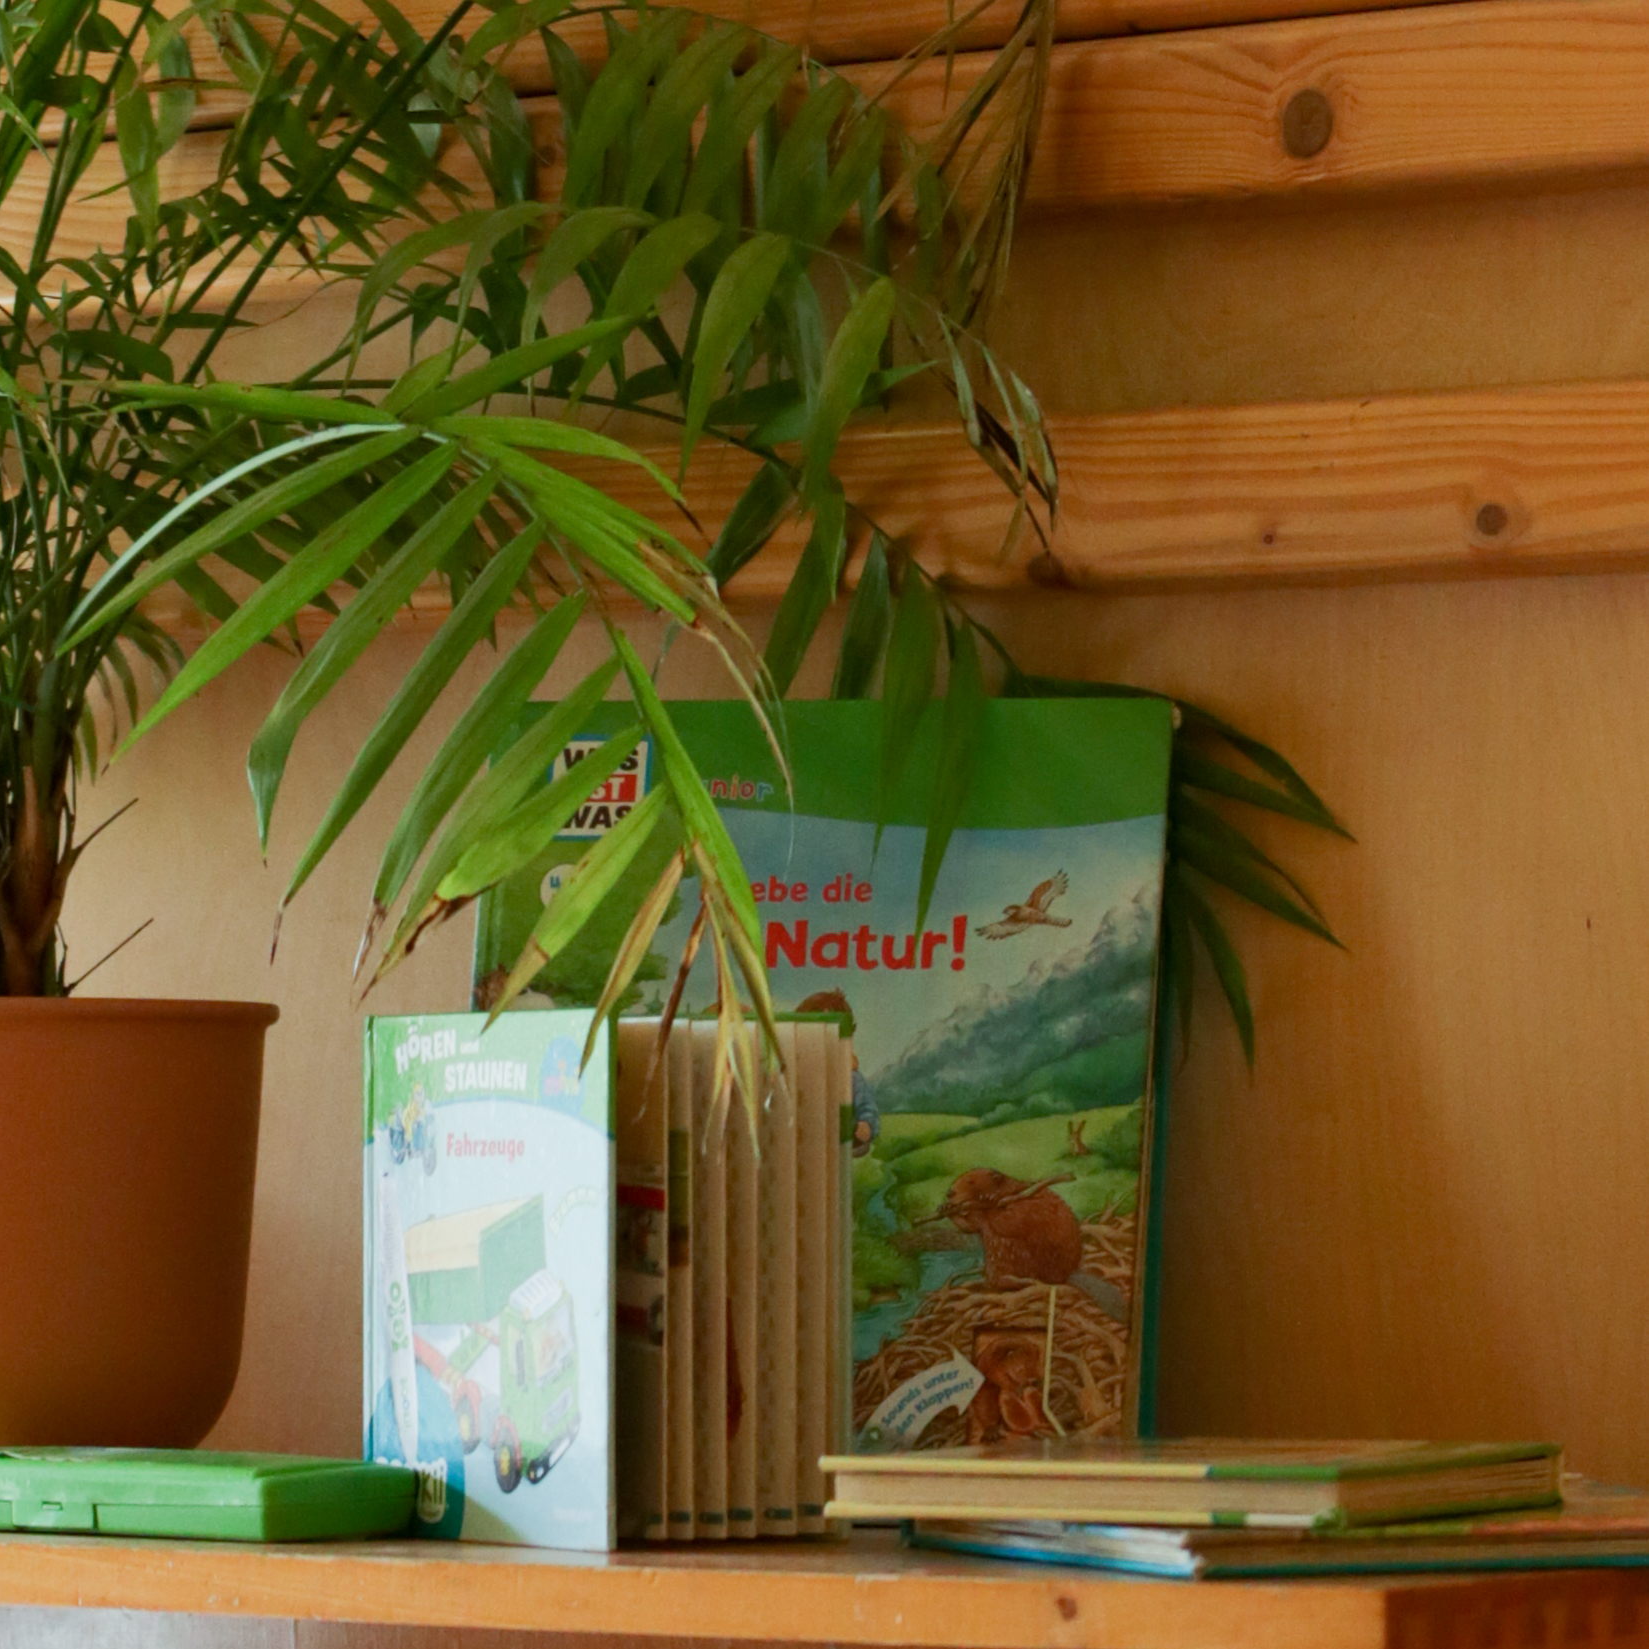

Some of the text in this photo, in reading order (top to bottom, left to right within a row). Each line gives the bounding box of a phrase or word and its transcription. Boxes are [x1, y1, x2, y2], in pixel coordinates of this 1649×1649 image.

[704, 772, 774, 802] nior
[821, 872, 873, 904] die
[764, 914, 968, 971] Natur!
[395, 1026, 457, 1076] HÖREN
[444, 1060, 528, 1092] STAUNEN
[446, 1131, 525, 1163] Fahrzeuge
